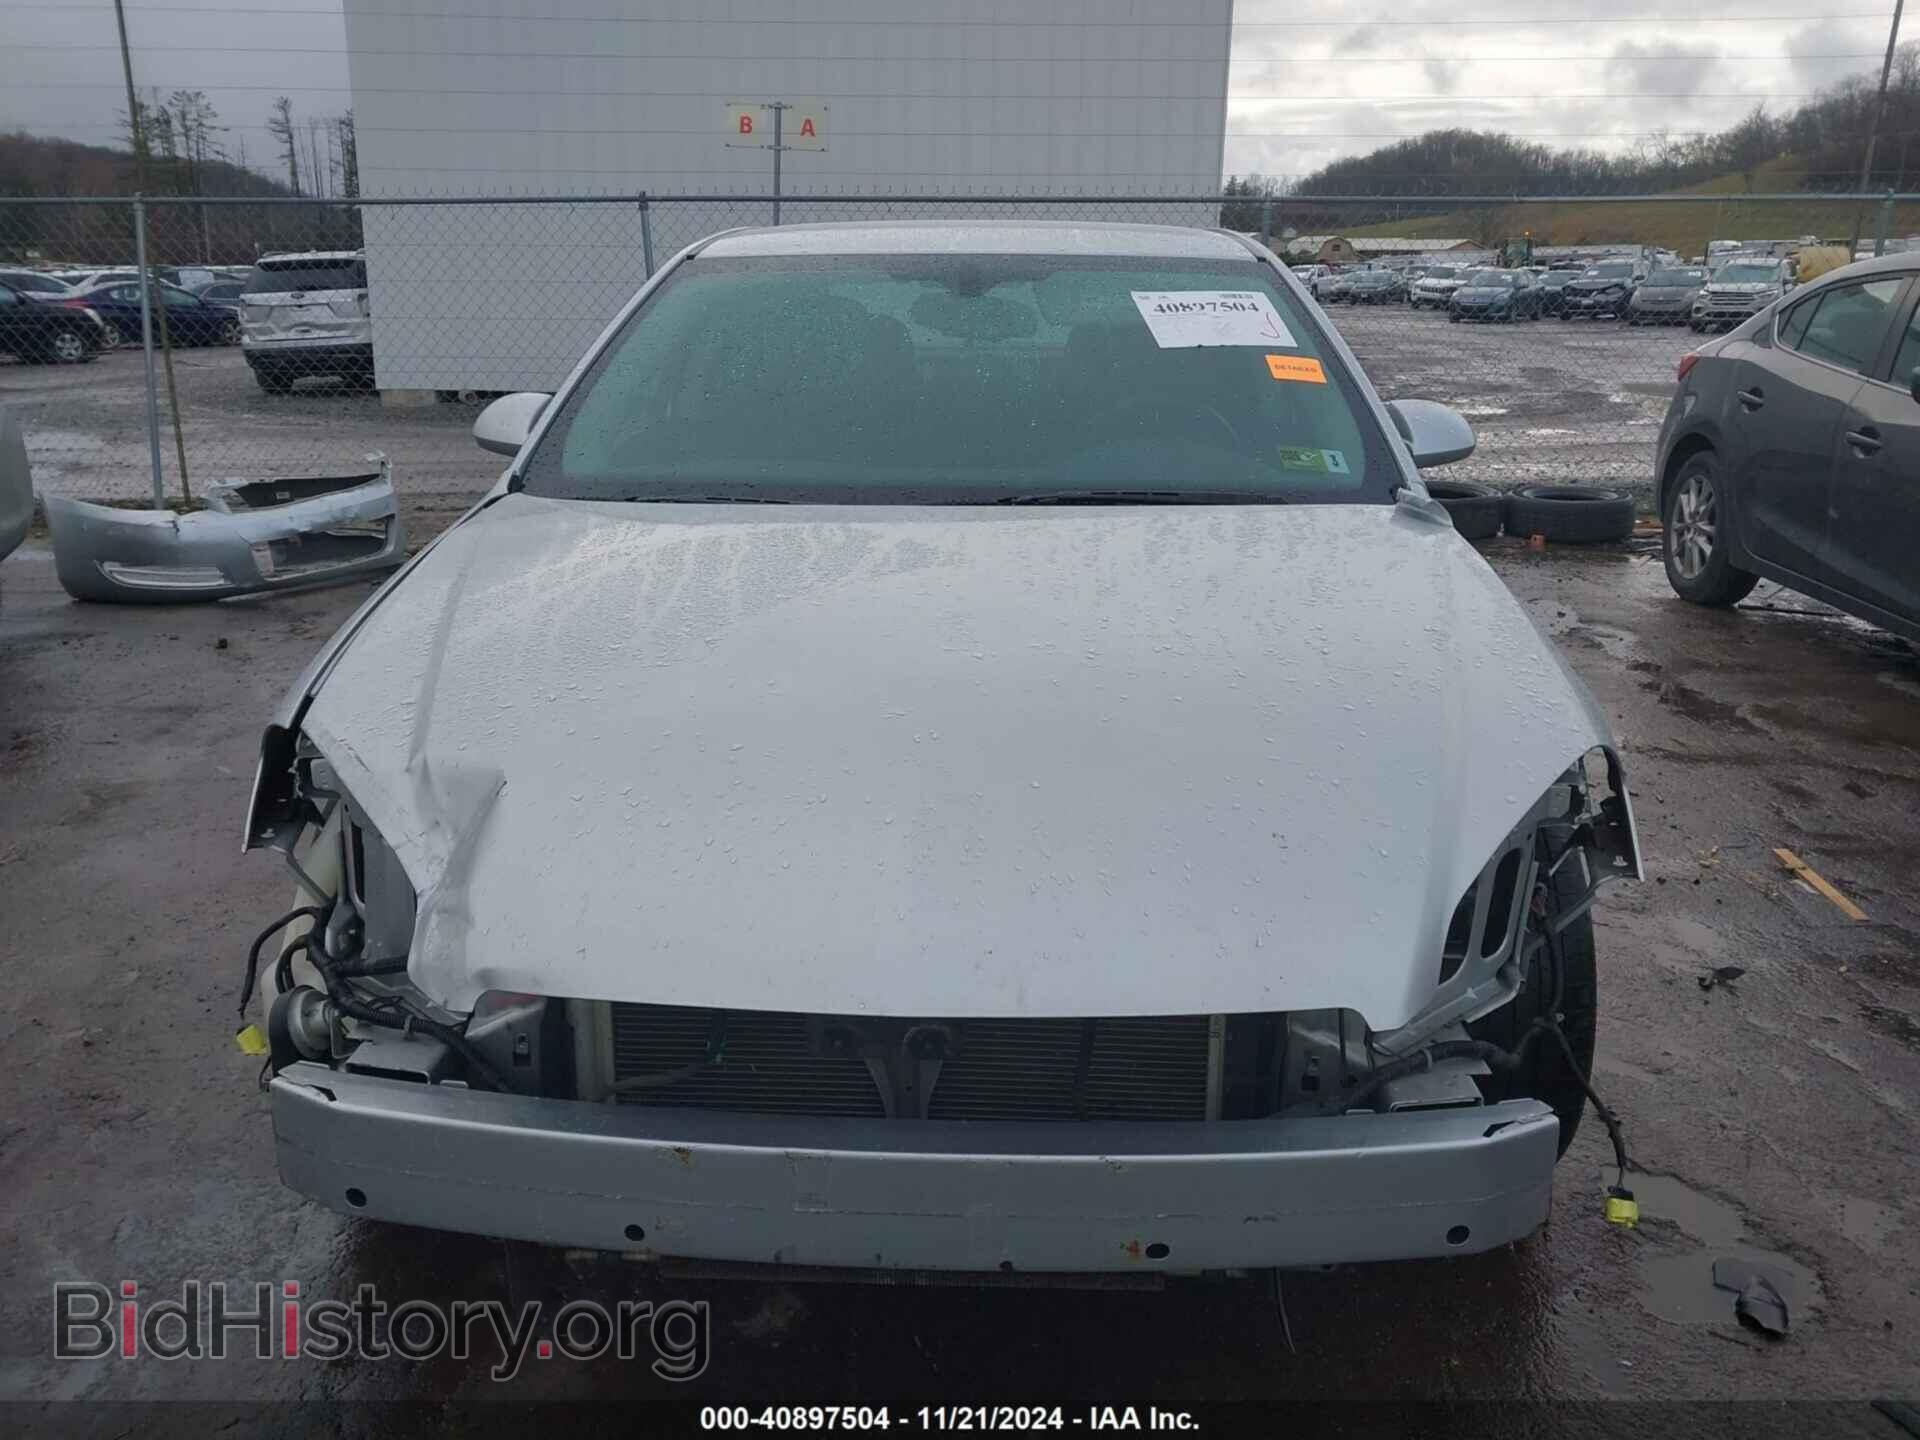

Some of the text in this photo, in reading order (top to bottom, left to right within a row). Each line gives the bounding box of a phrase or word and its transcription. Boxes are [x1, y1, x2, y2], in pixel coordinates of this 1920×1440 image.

[739, 115, 753, 134] B
[800, 118, 816, 137] A
[1154, 301, 1260, 314] 40897504
